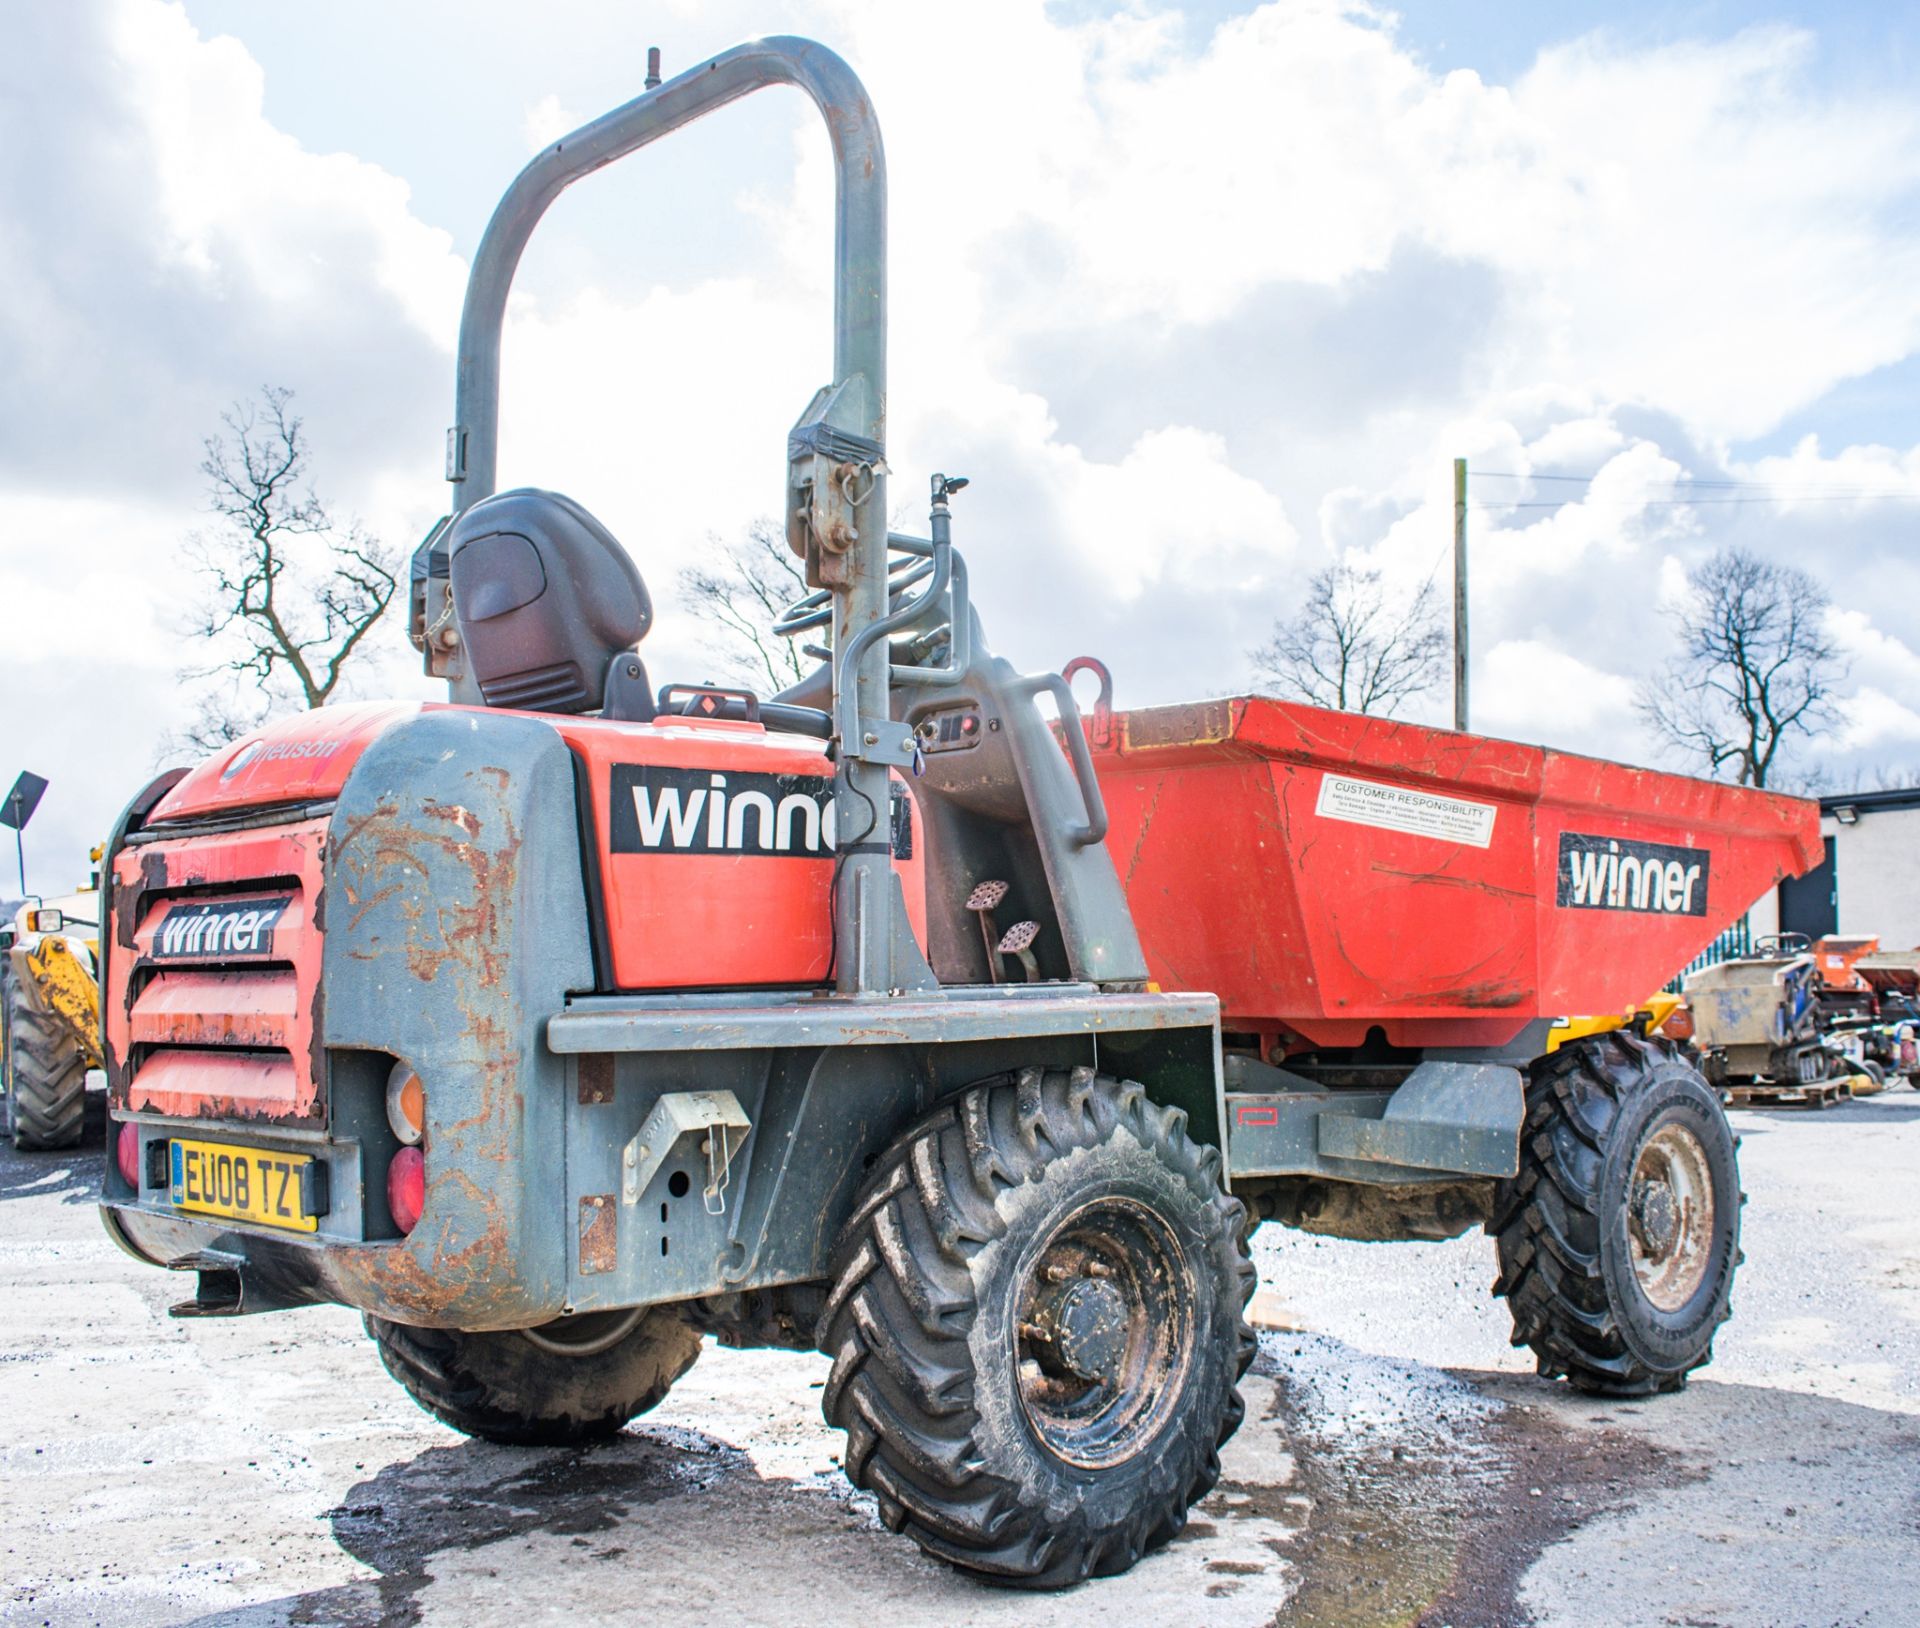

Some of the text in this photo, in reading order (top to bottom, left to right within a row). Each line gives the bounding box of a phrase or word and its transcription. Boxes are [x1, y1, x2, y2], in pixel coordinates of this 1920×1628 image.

[632, 774, 894, 850] winn
[1335, 782, 1395, 801] CUSTOMER
[1398, 792, 1485, 817] RESPONSIBILITY
[1570, 840, 1700, 911] winner
[163, 907, 277, 953] winner
[186, 1151, 250, 1209] EU08
